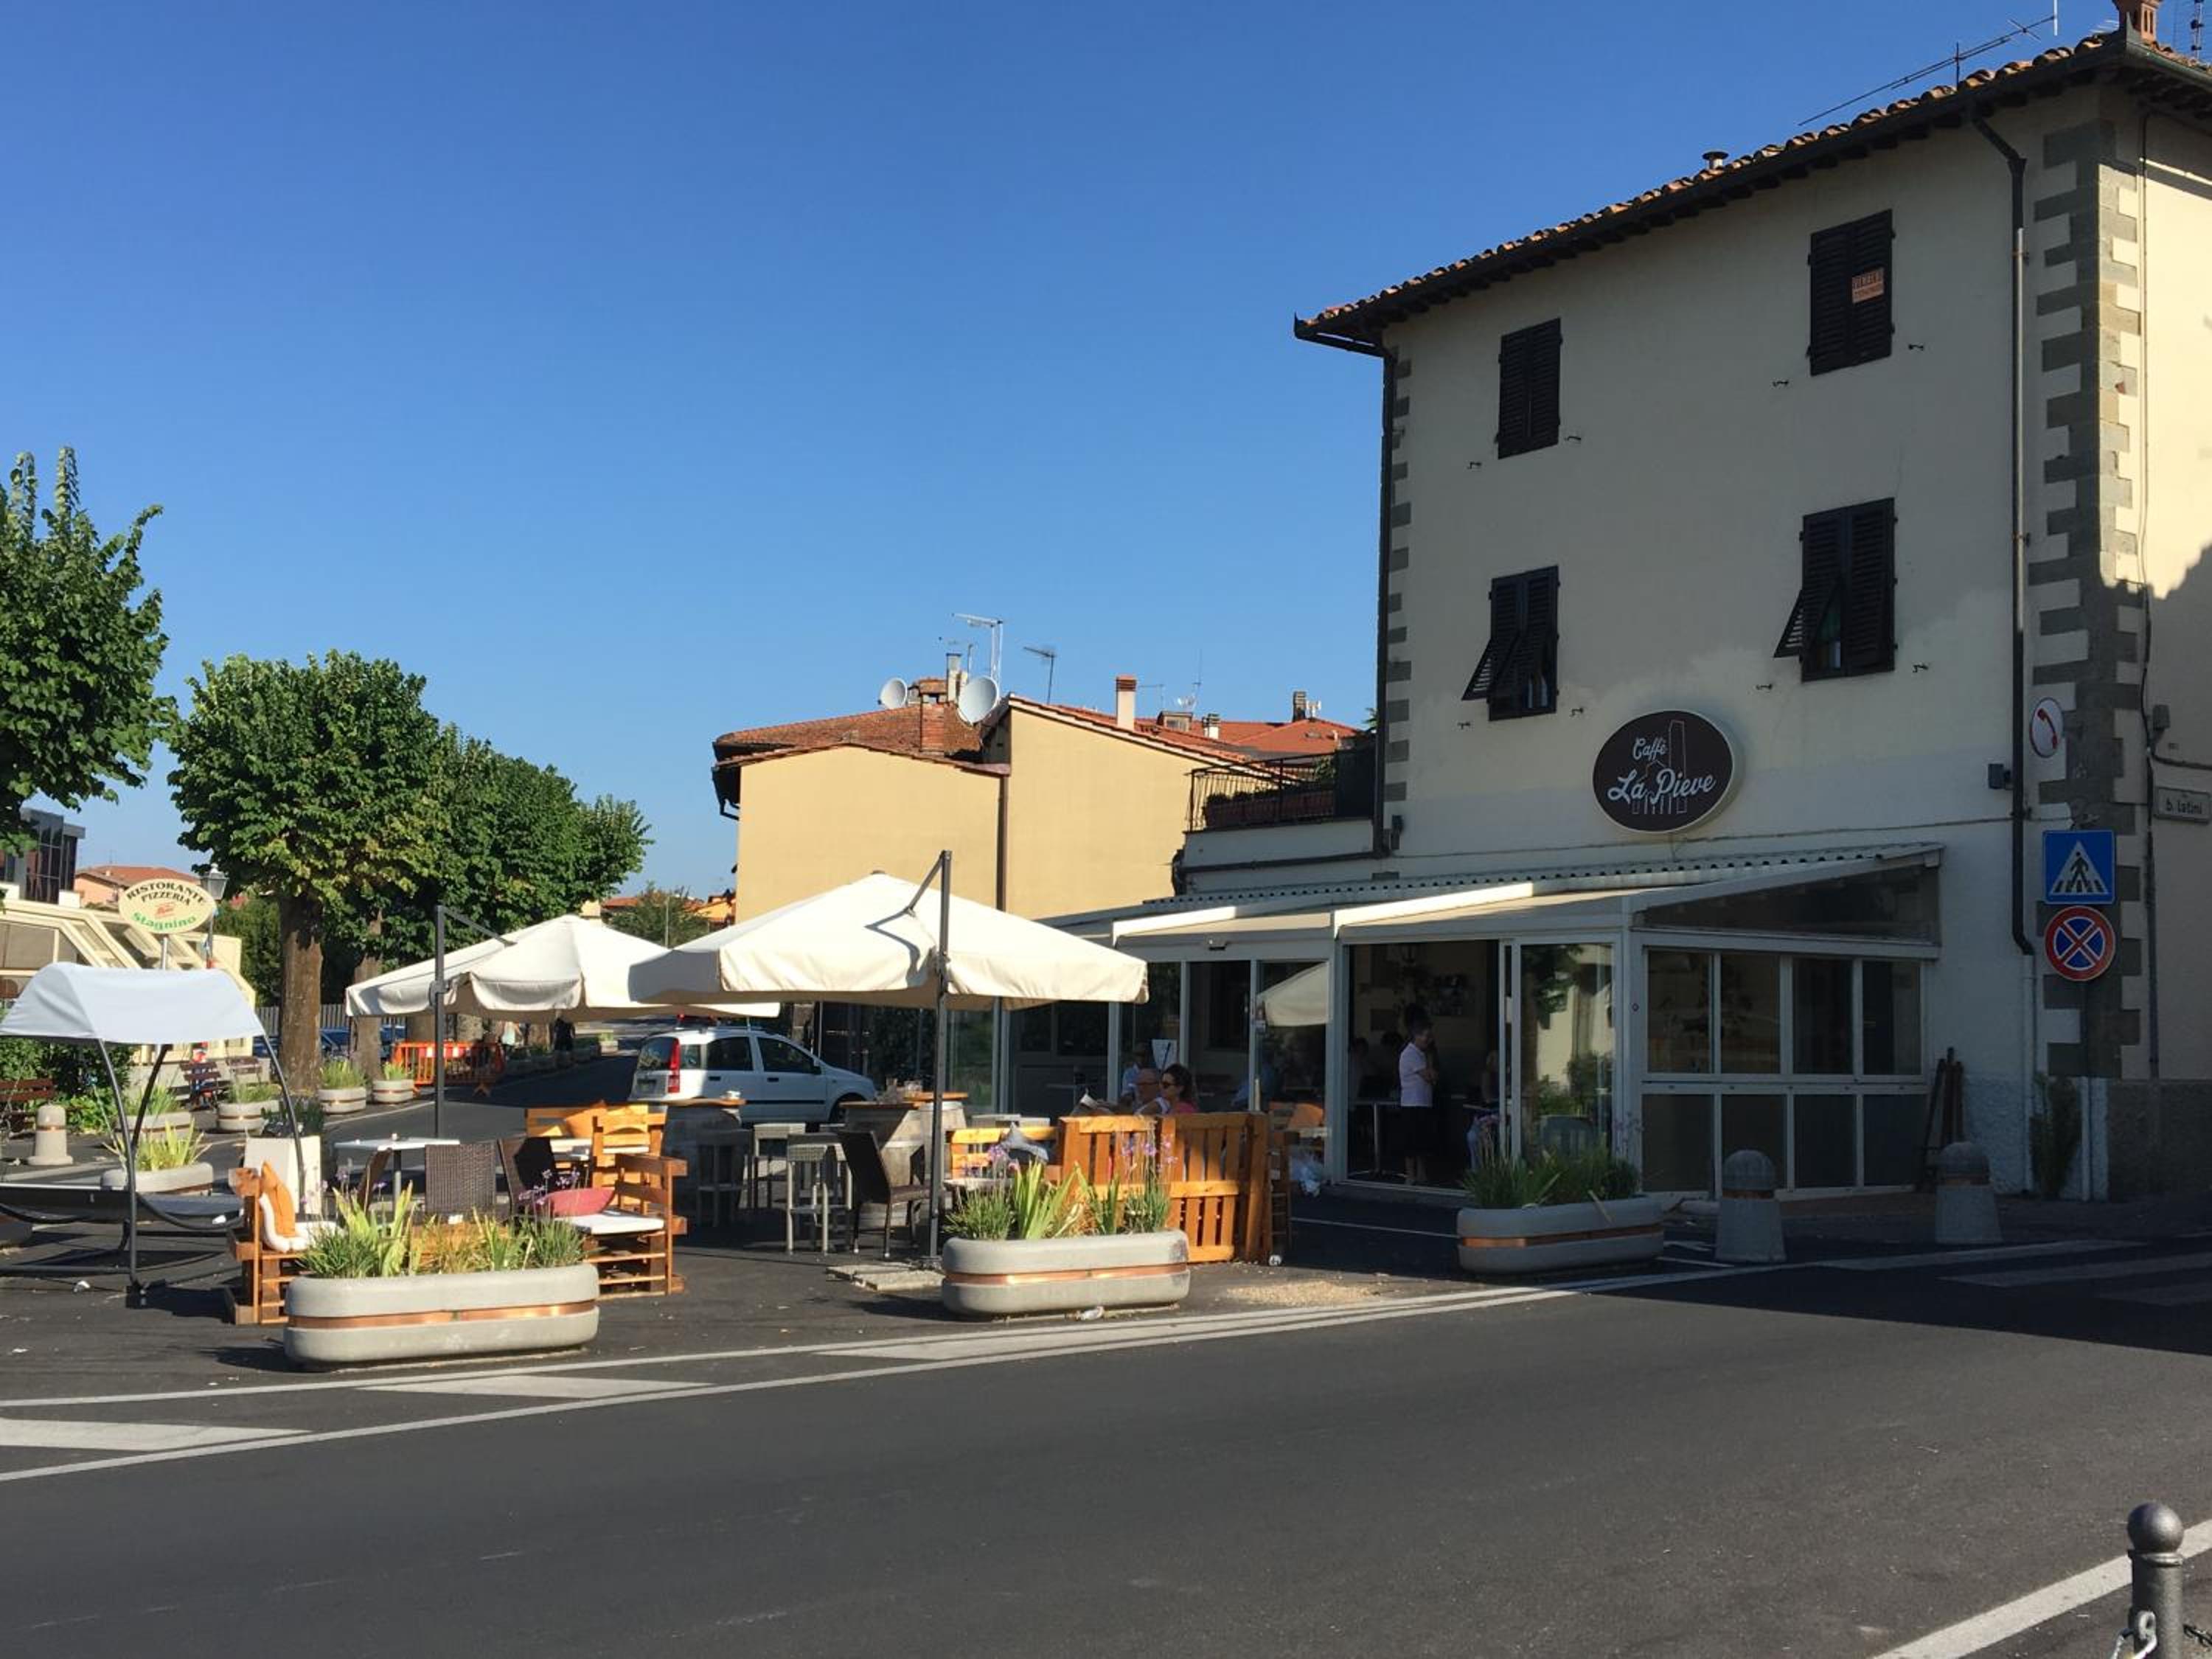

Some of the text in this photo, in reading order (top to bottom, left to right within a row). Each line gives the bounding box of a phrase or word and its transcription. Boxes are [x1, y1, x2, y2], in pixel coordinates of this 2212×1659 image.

[1607, 768, 1717, 804] La Pieve
[126, 882, 204, 903] RISTORANTE
[141, 891, 191, 906] PIZZERIA
[133, 911, 197, 931] Stagnino
